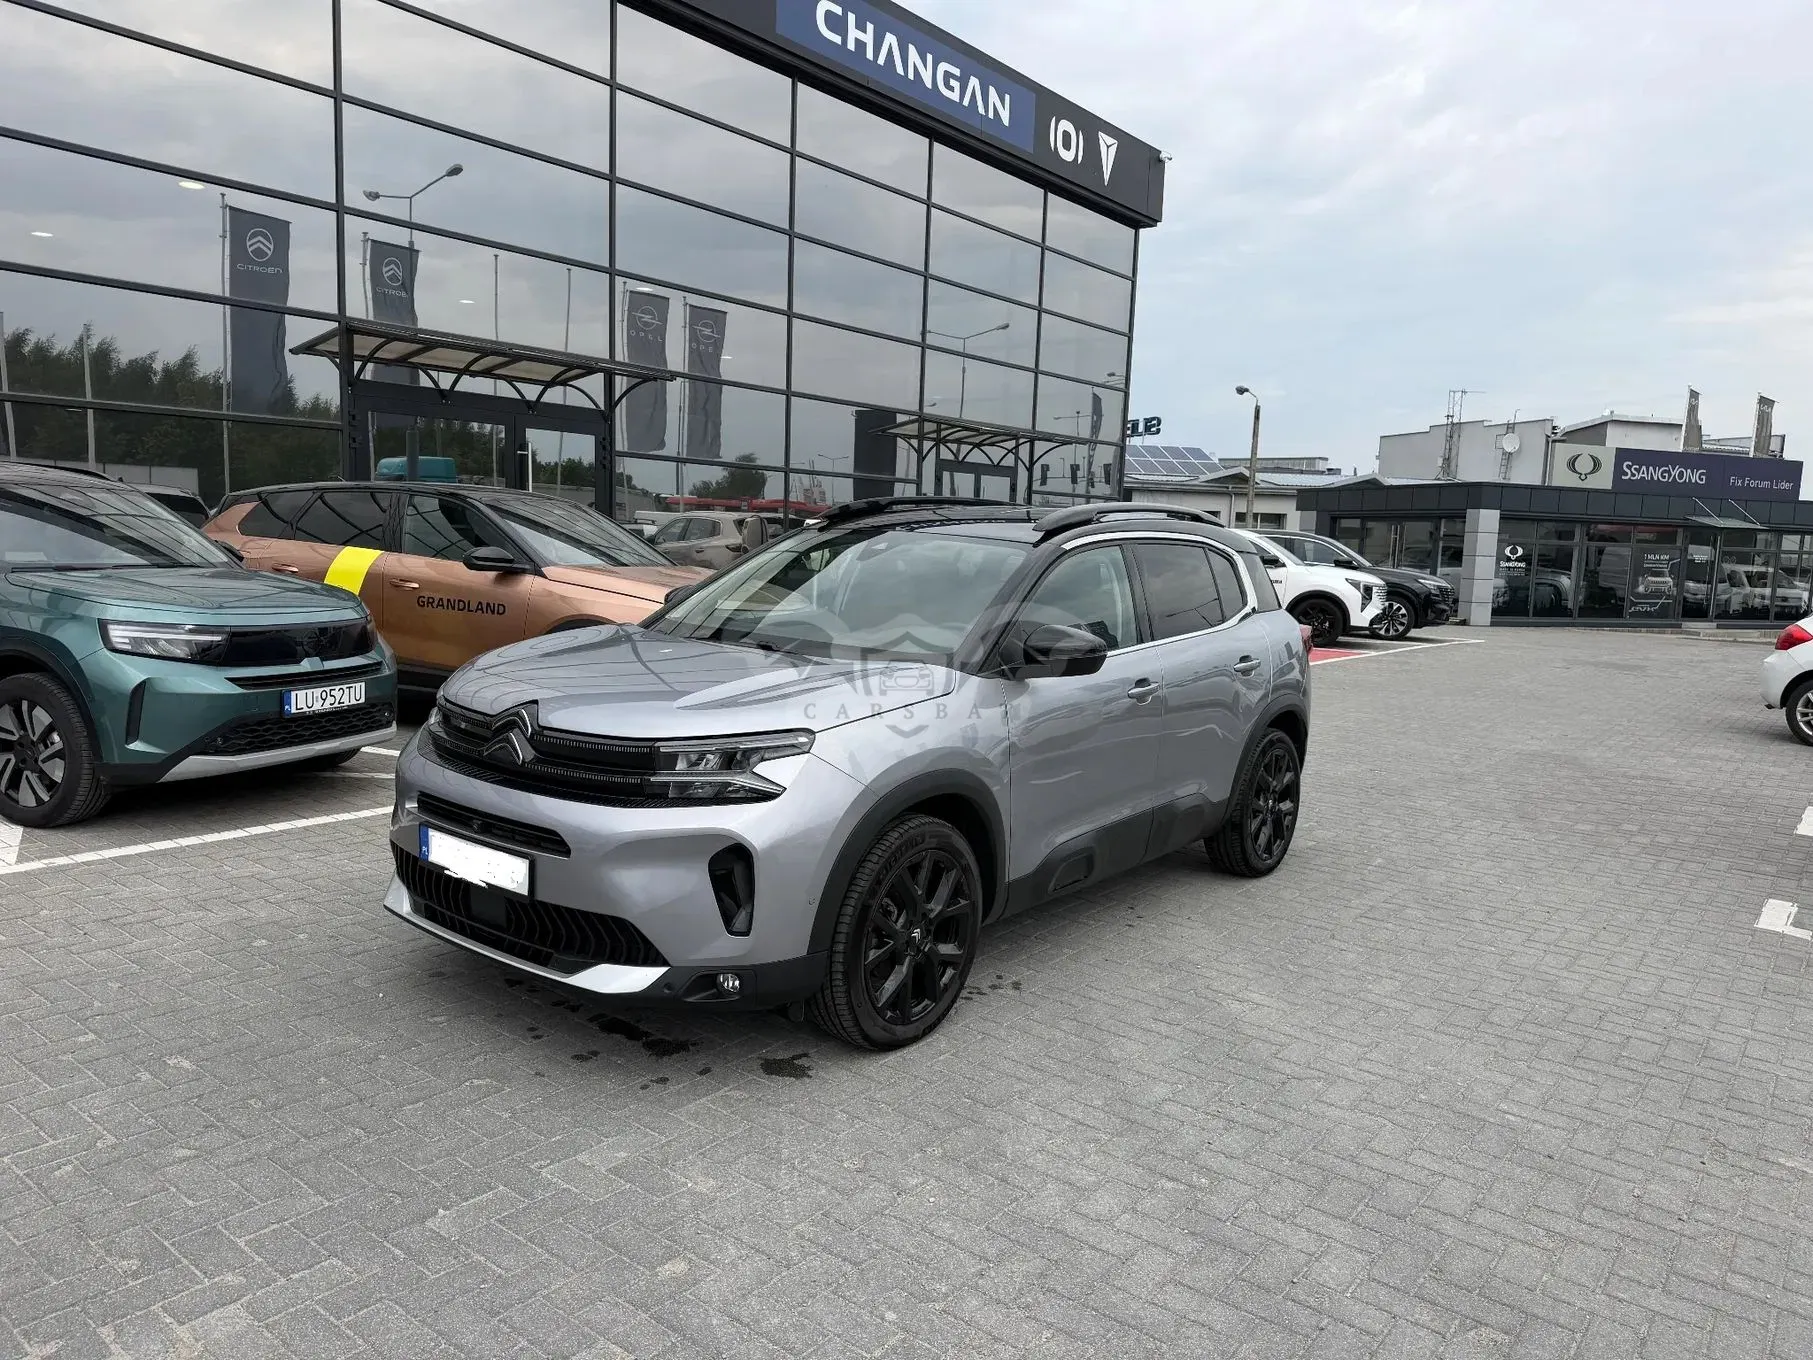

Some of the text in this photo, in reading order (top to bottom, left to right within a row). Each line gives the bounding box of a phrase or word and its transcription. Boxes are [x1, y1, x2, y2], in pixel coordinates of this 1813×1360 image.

[816, 0, 1010, 127] CHANGAN
[1729, 476, 1794, 490] Fix Forum Lider
[416, 595, 506, 616] GRANDLAND
[295, 691, 315, 711] LU
[320, 684, 362, 708] 952TU
